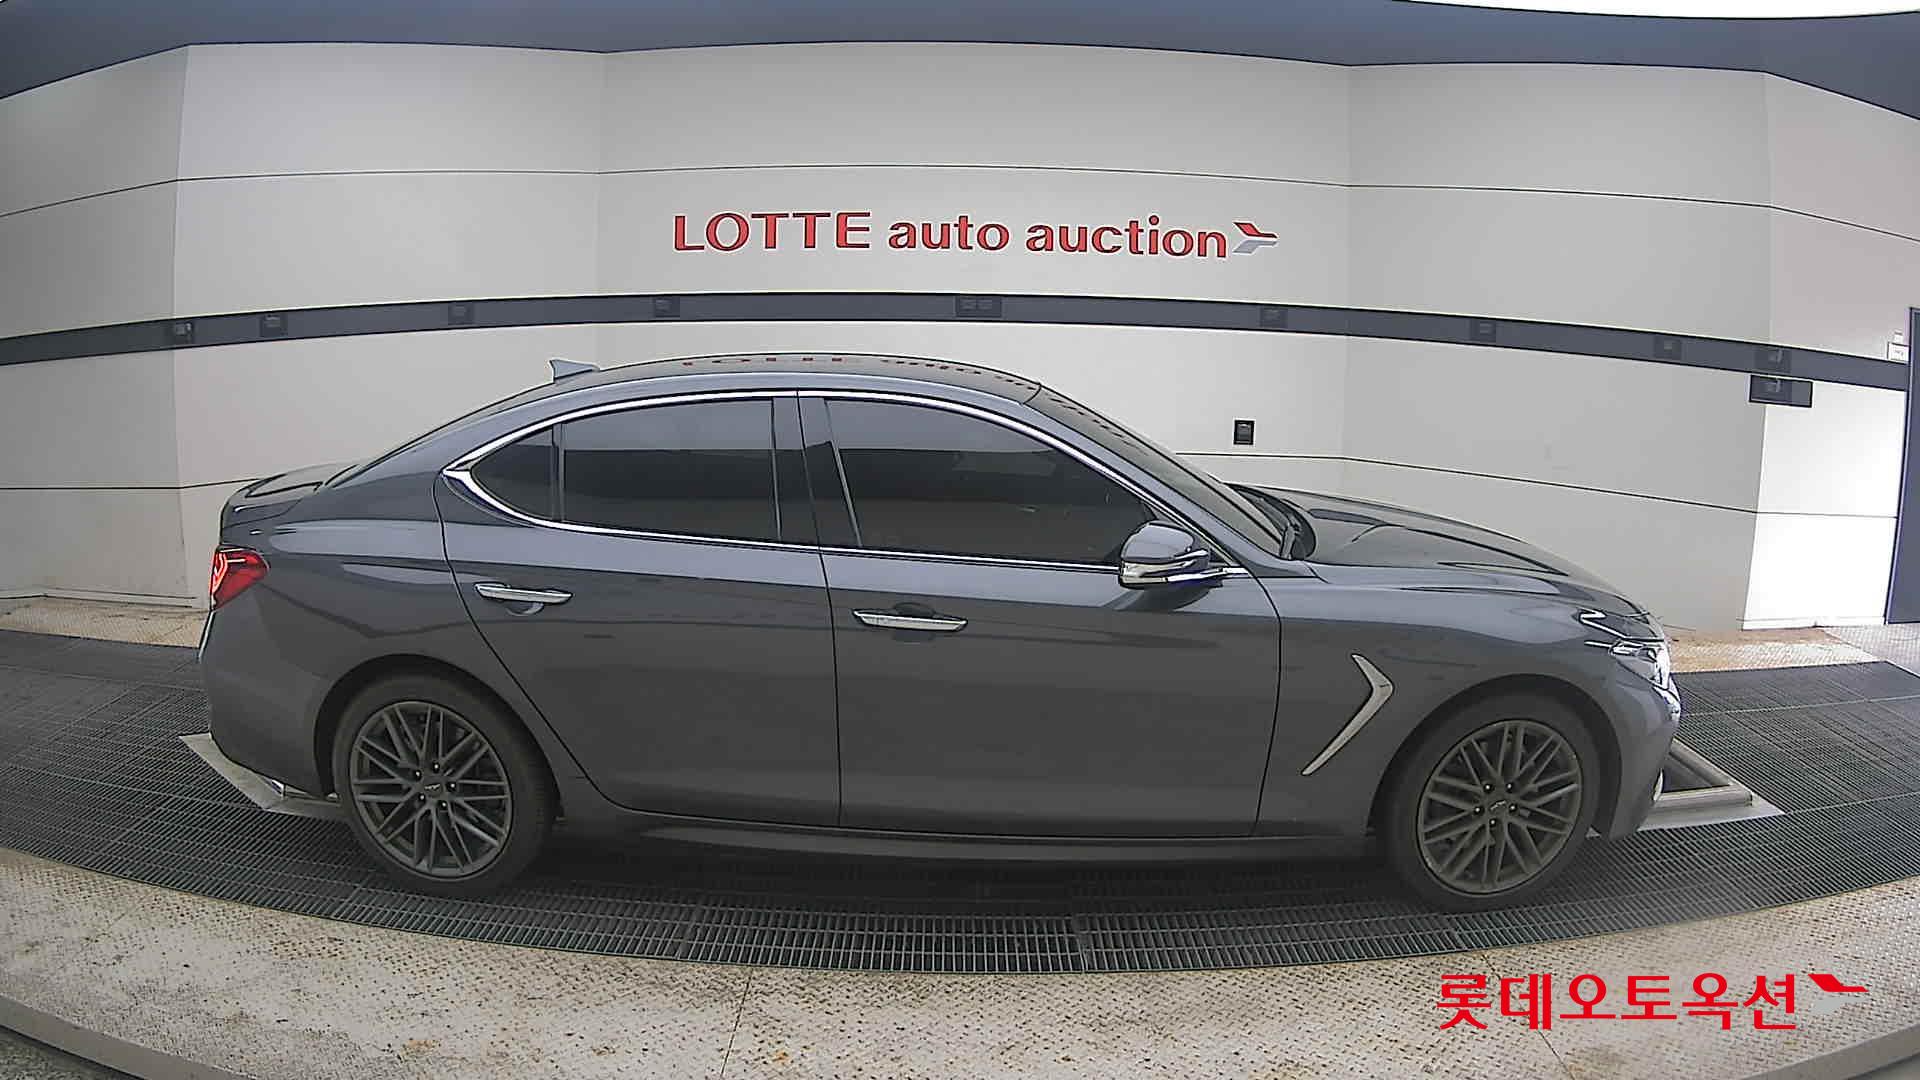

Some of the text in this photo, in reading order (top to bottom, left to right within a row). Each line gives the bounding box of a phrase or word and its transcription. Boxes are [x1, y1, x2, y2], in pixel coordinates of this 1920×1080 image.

[674, 212, 1228, 258] LOTTE auto auction
